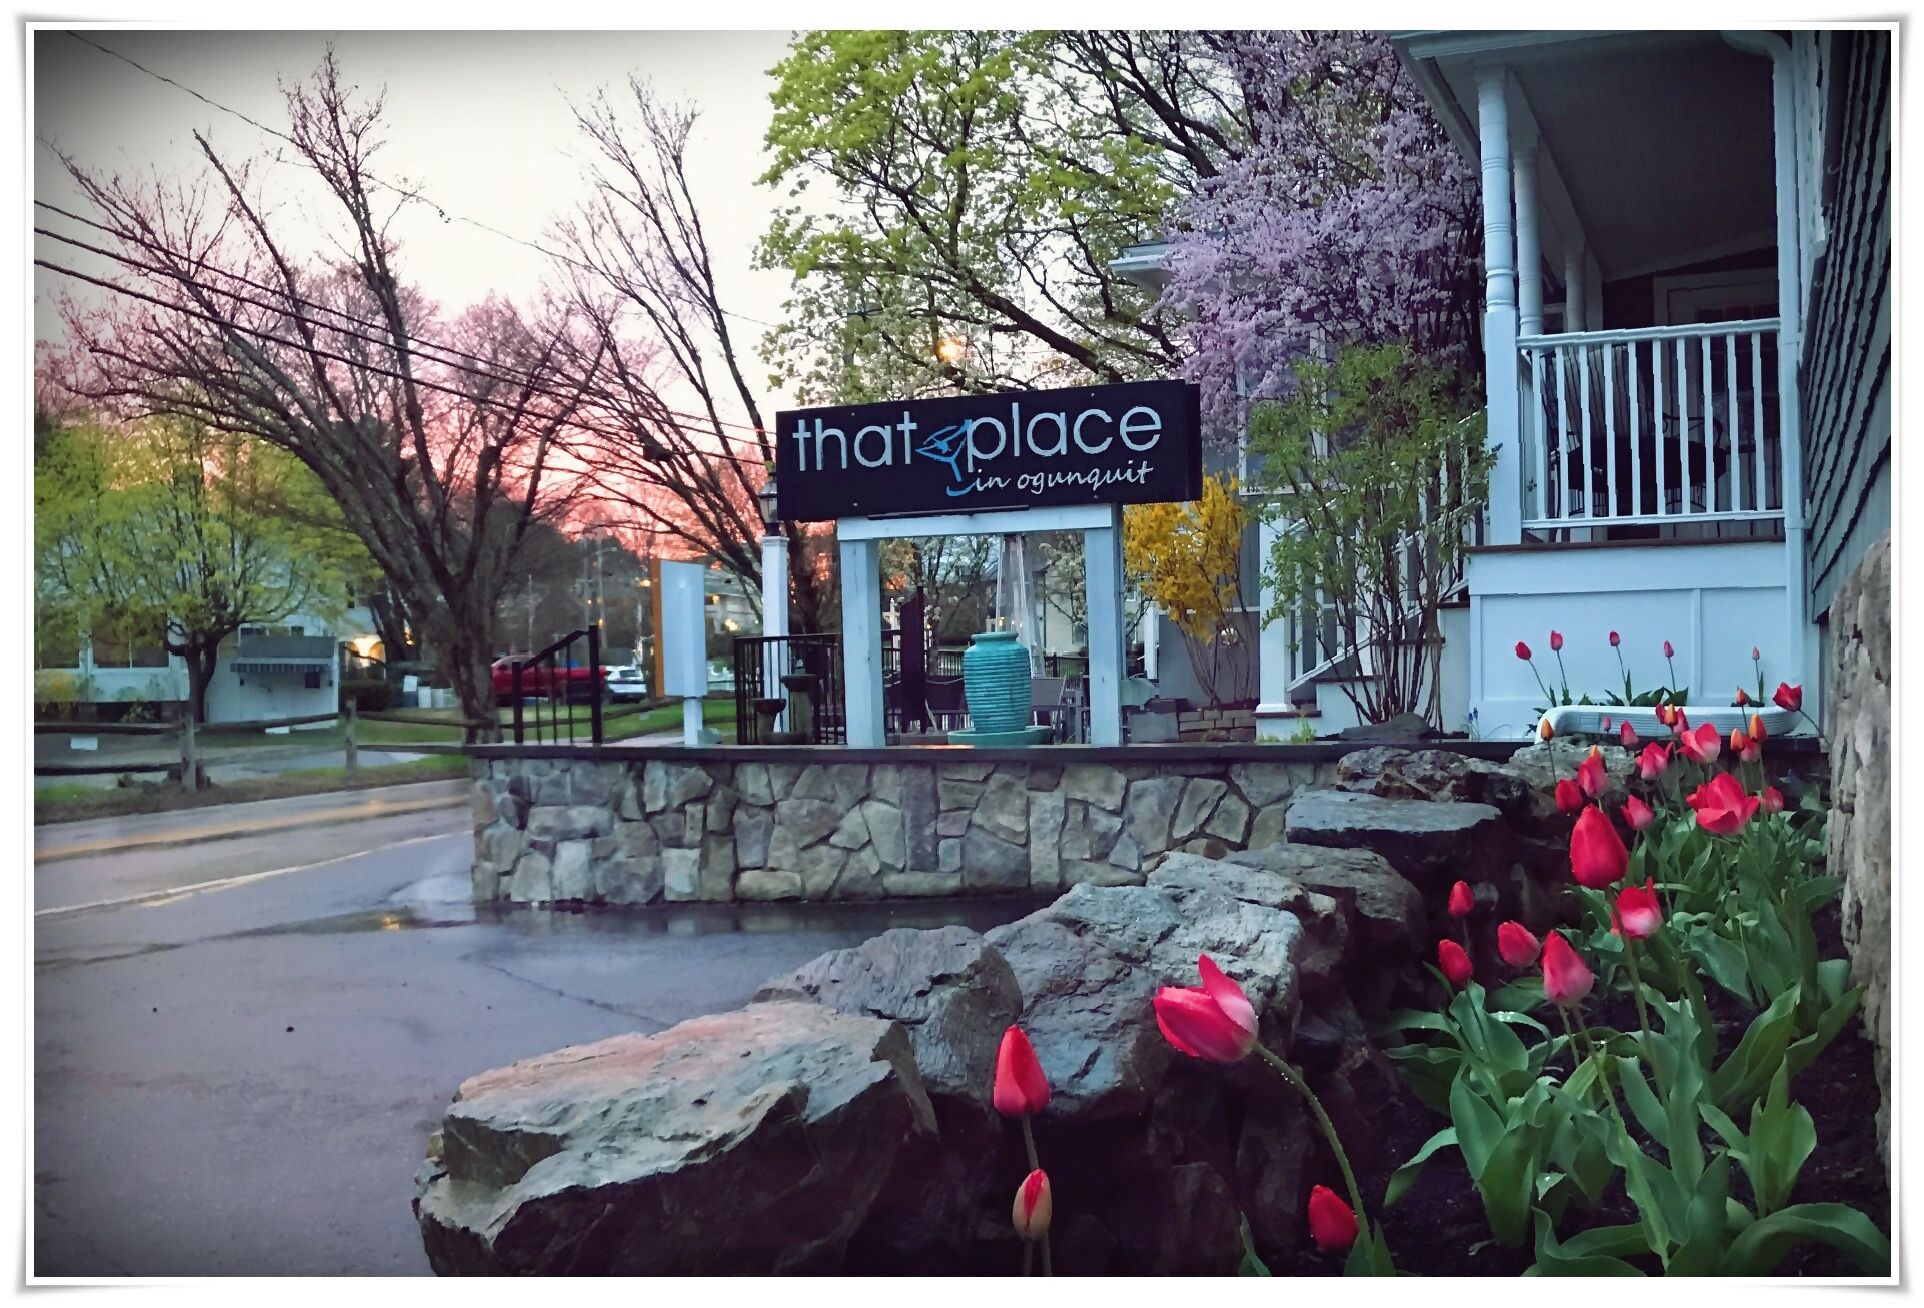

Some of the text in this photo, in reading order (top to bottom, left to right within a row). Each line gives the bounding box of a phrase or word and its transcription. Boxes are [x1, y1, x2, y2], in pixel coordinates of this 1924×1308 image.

[792, 402, 1162, 473] that place
[972, 460, 1155, 494] in ogunquit
